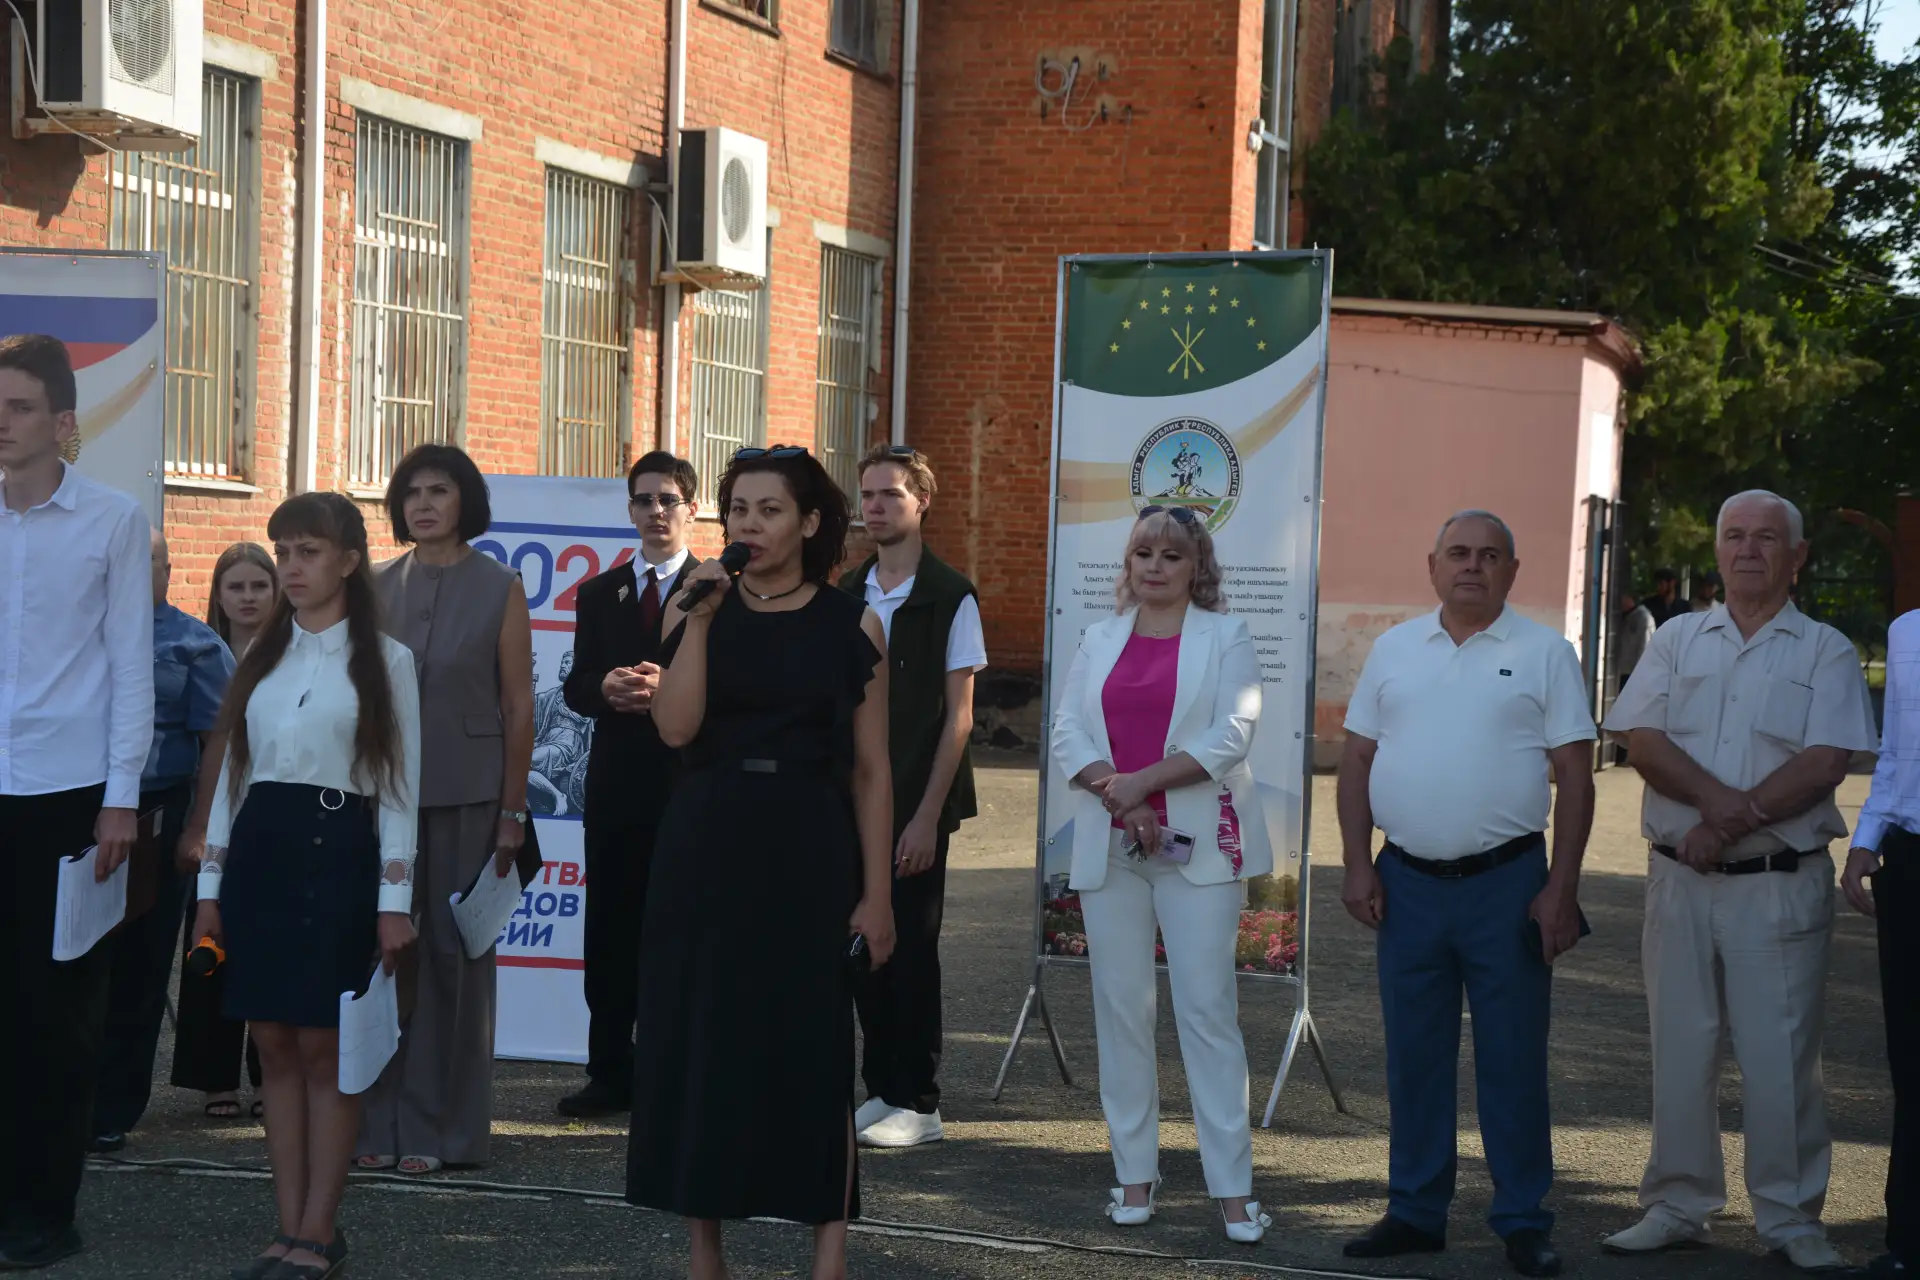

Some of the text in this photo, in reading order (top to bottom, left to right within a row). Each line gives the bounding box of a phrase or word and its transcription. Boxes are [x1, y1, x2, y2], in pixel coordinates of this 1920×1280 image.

[1132, 423, 1180, 493] АДЫГЭ РЕСПУБЛИК
[1191, 421, 1239, 495] РЕСПУБЛИКА АДЫГЕЯ
[471, 540, 636, 611] 02
